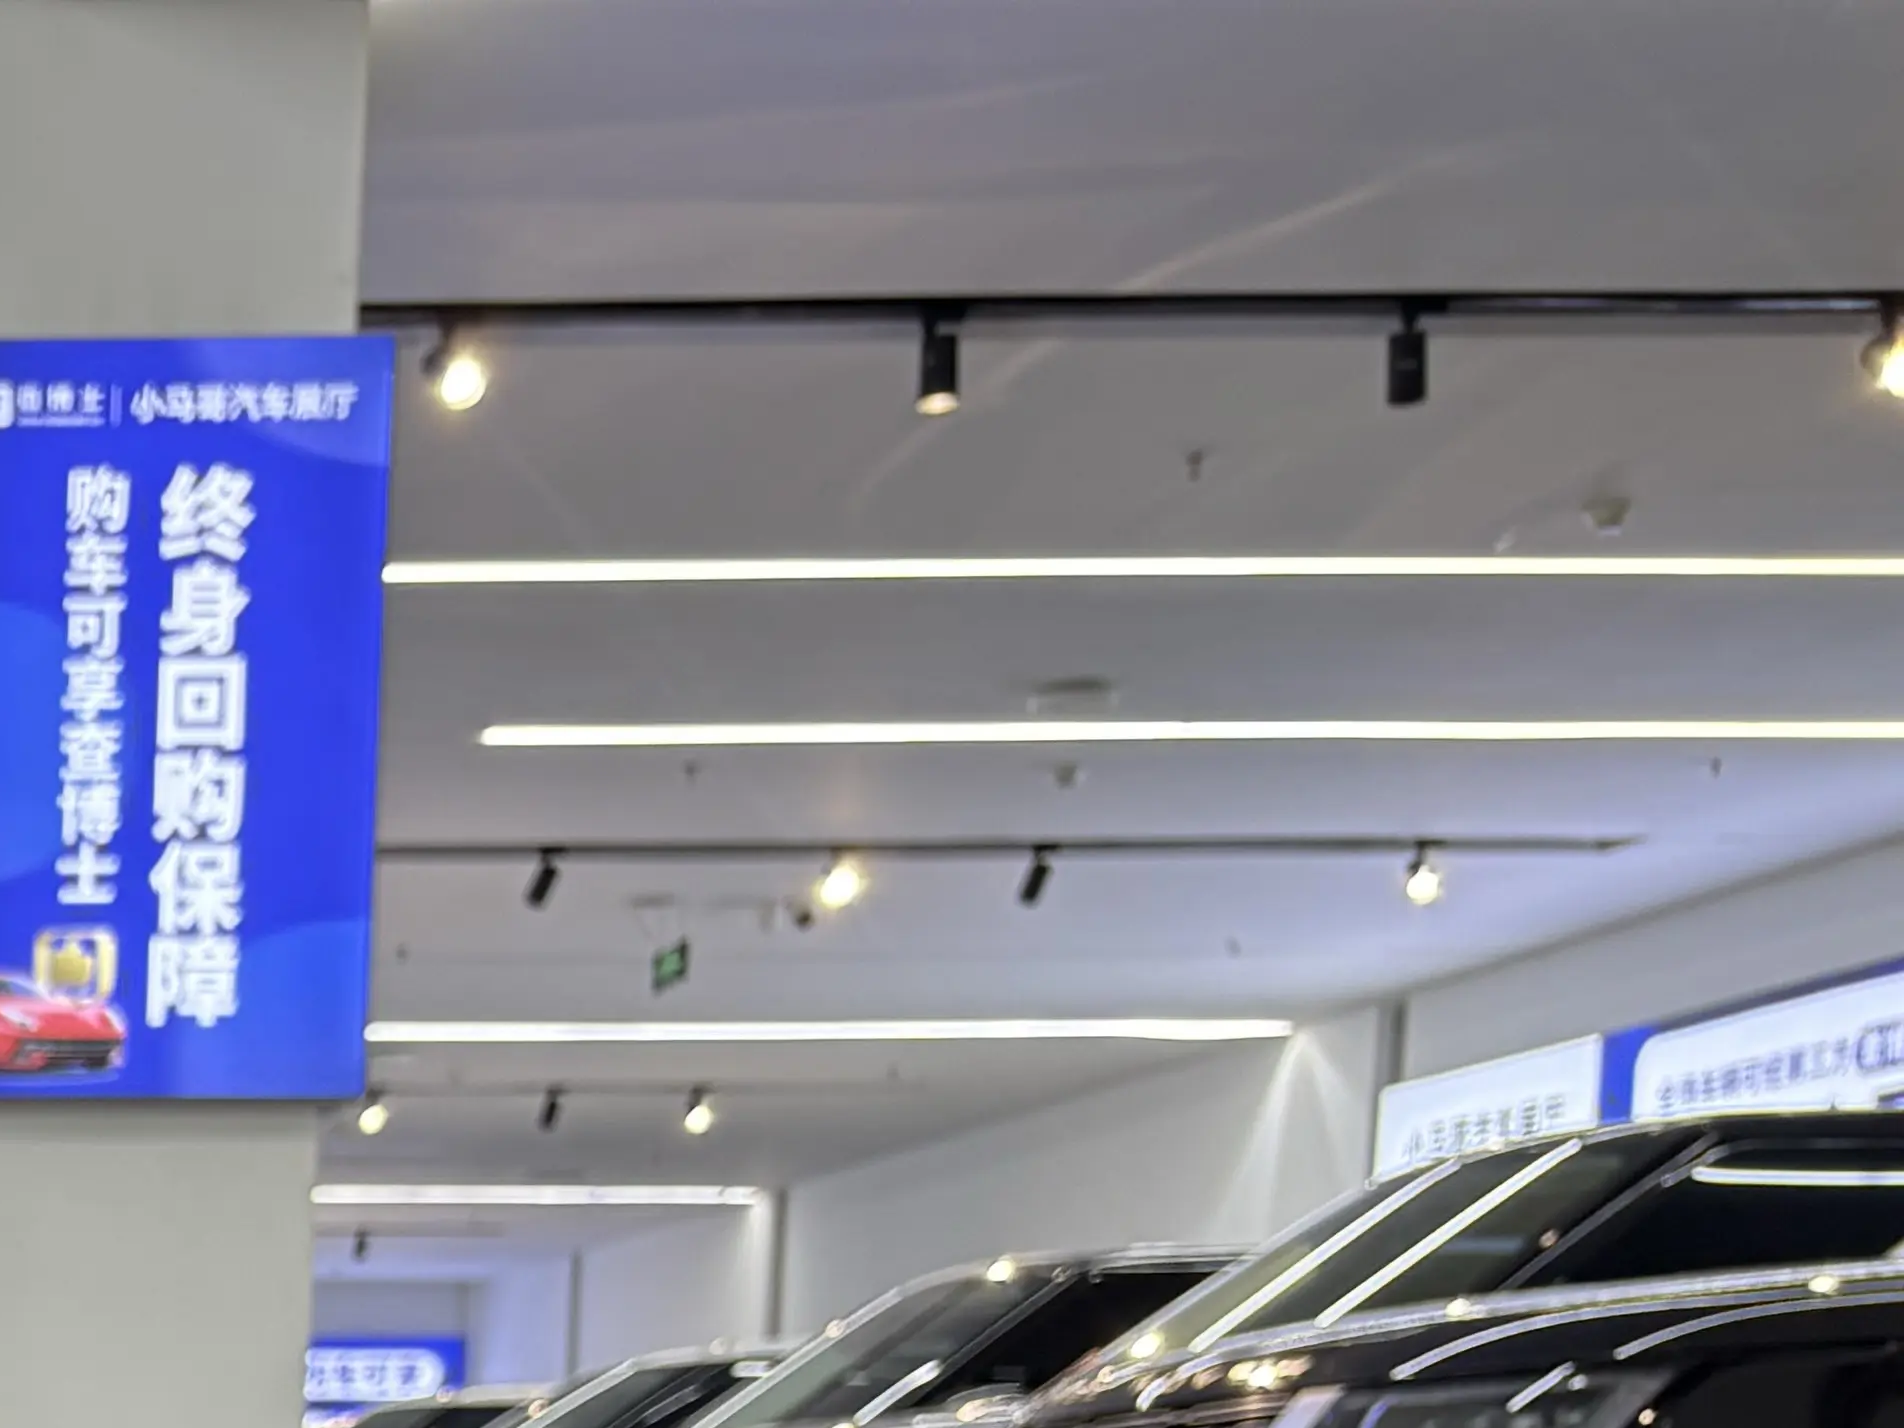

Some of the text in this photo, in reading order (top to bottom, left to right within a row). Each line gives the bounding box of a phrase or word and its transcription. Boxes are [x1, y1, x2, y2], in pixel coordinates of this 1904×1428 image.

[56, 463, 132, 905] 购车可享查博士
[145, 462, 257, 1030] 终身回购保障
